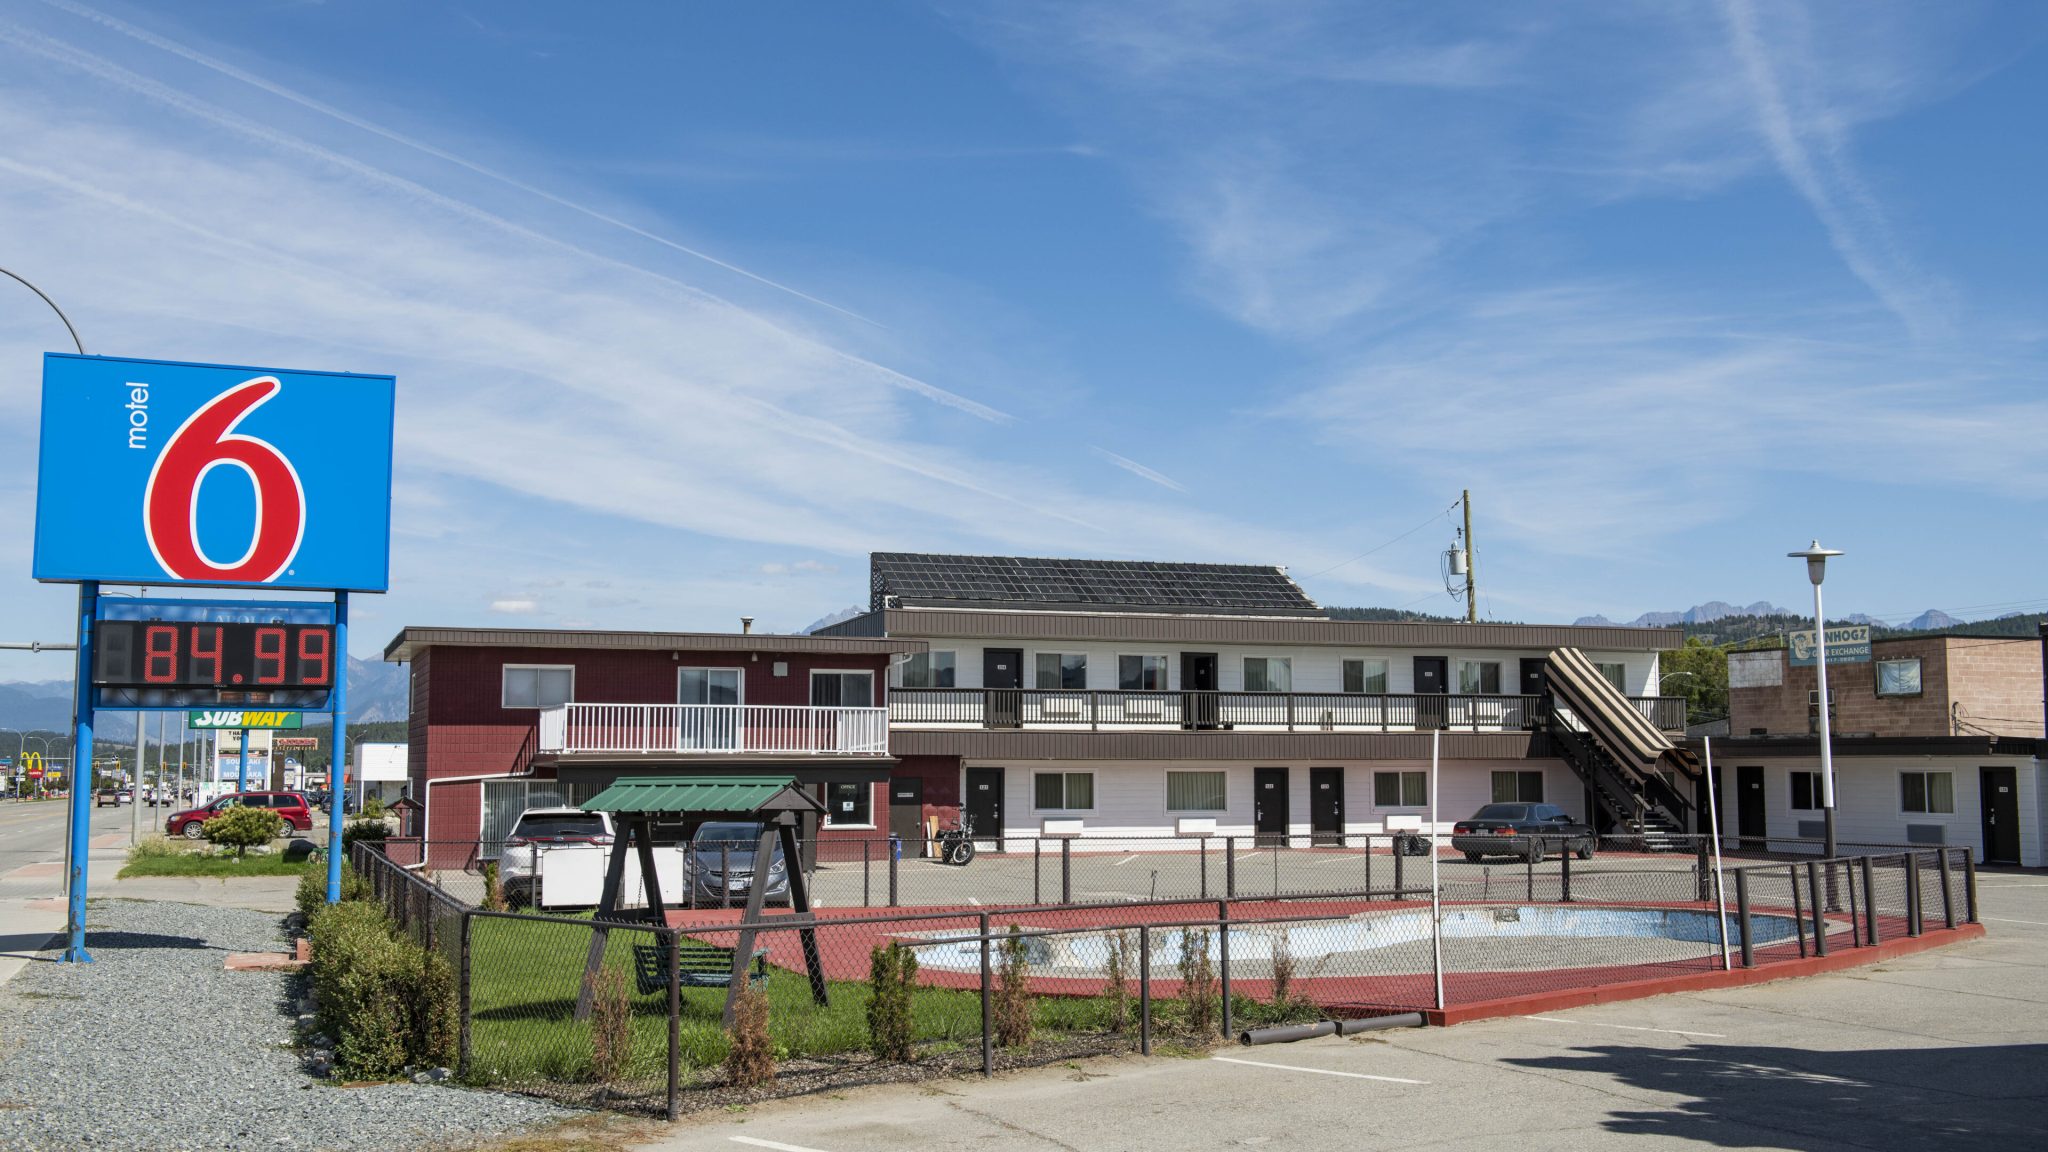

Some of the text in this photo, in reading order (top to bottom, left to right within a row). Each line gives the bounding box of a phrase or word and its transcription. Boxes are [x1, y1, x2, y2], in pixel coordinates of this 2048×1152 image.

[126, 382, 149, 449] motel
[143, 376, 306, 583] 6
[1811, 628, 1867, 644] FNHOGZ
[1831, 646, 1869, 656] EXCHANGE
[144, 626, 330, 685] 84.99
[195, 711, 293, 727] SUBWAY
